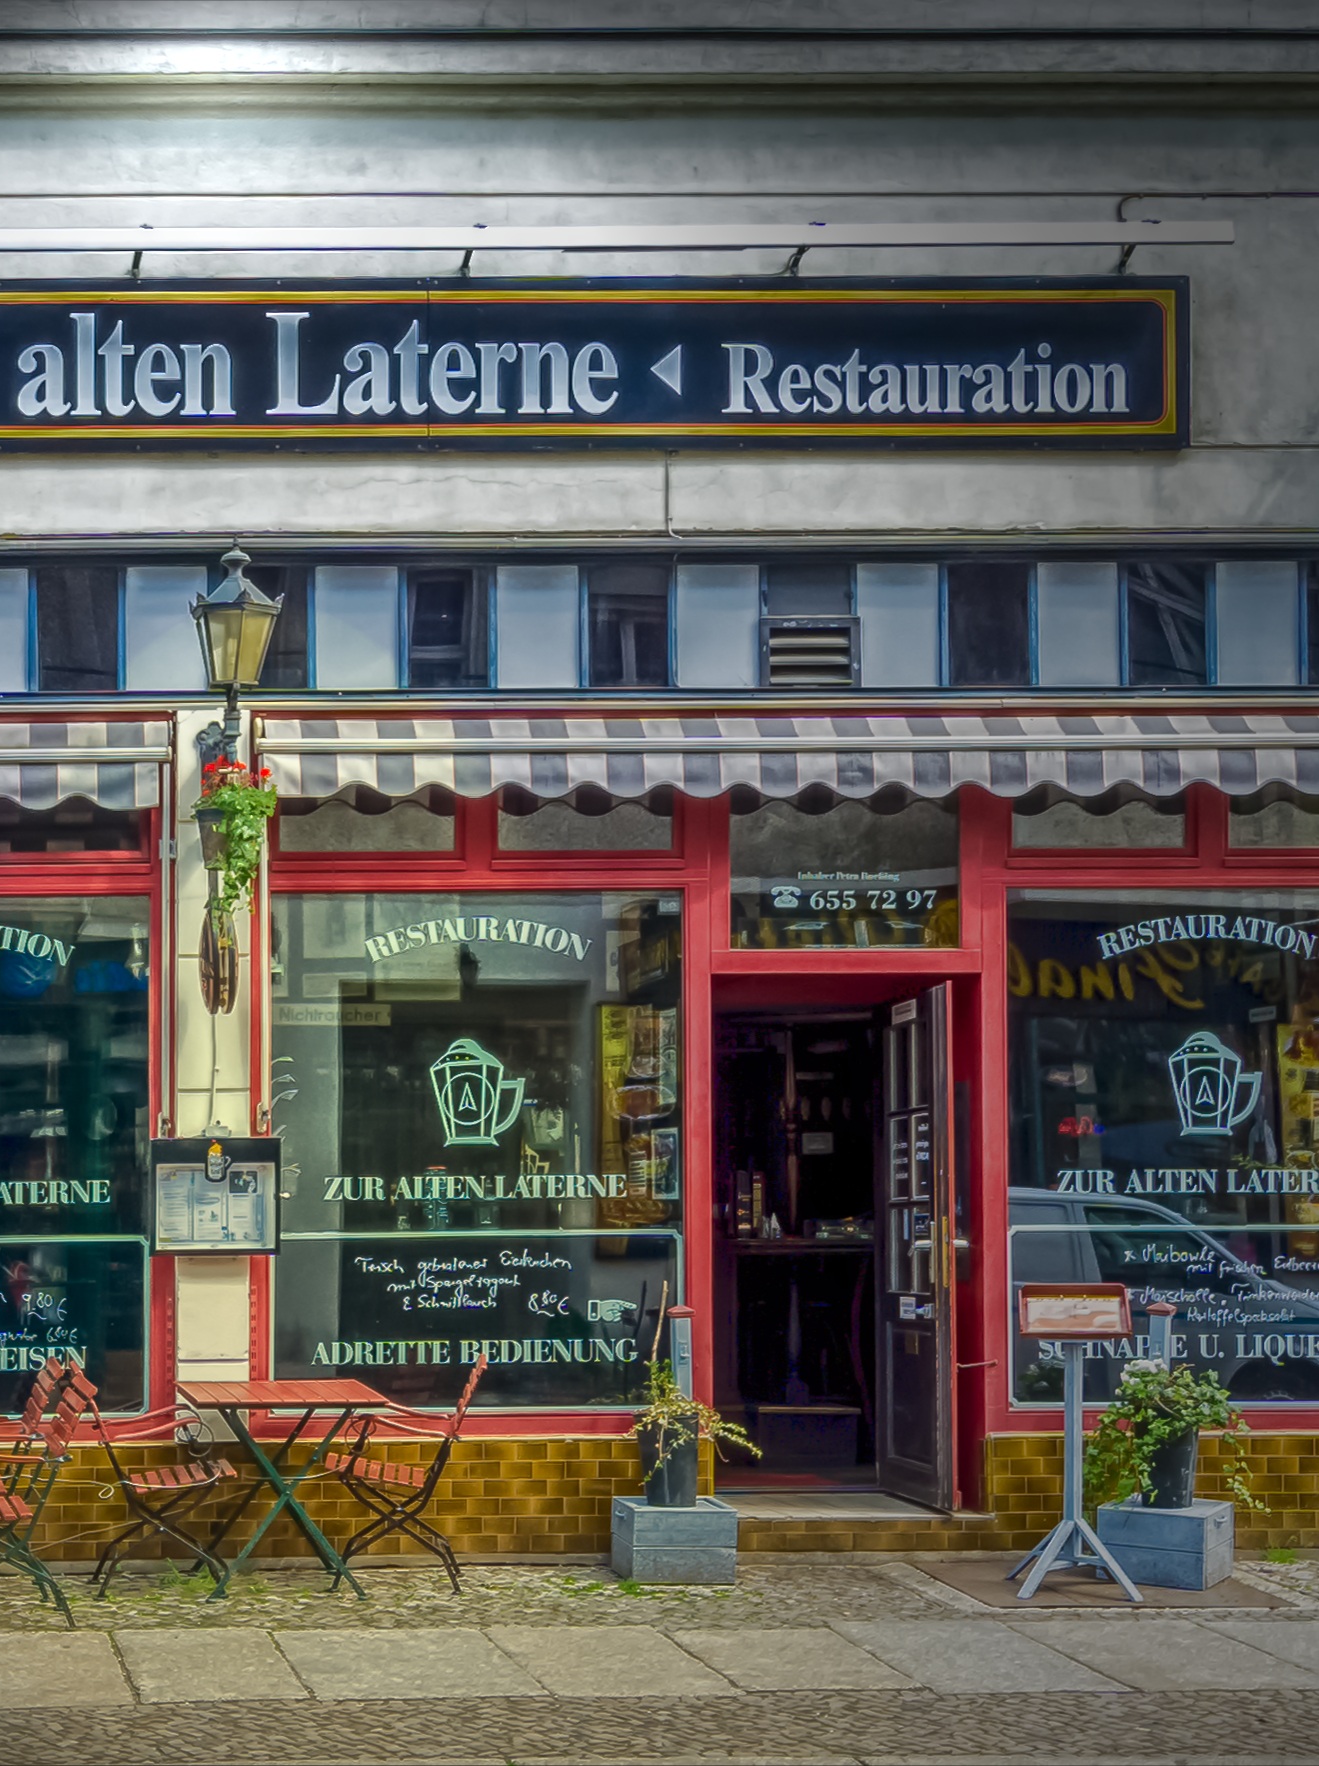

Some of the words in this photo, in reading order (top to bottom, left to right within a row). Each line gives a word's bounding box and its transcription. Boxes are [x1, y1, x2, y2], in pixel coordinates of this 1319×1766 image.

[16, 312, 236, 418] alten
[266, 311, 619, 416] Laterne
[720, 343, 1130, 414] Restauration
[809, 889, 856, 910] 655
[866, 889, 897, 910] 72
[906, 889, 938, 910] 97
[364, 916, 592, 963] RESTAURATION
[1096, 914, 1318, 960] RESTAURATION
[323, 1179, 386, 1204] ZUR
[394, 1178, 486, 1204] ALTEN
[494, 1176, 628, 1202] LATERNE
[1056, 1169, 1117, 1194] ZUR
[1123, 1168, 1220, 1194] ALTEN
[312, 1341, 450, 1366] ADRETTE
[460, 1338, 638, 1364] BEDIENUNG
[1199, 1334, 1228, 1360] U.
